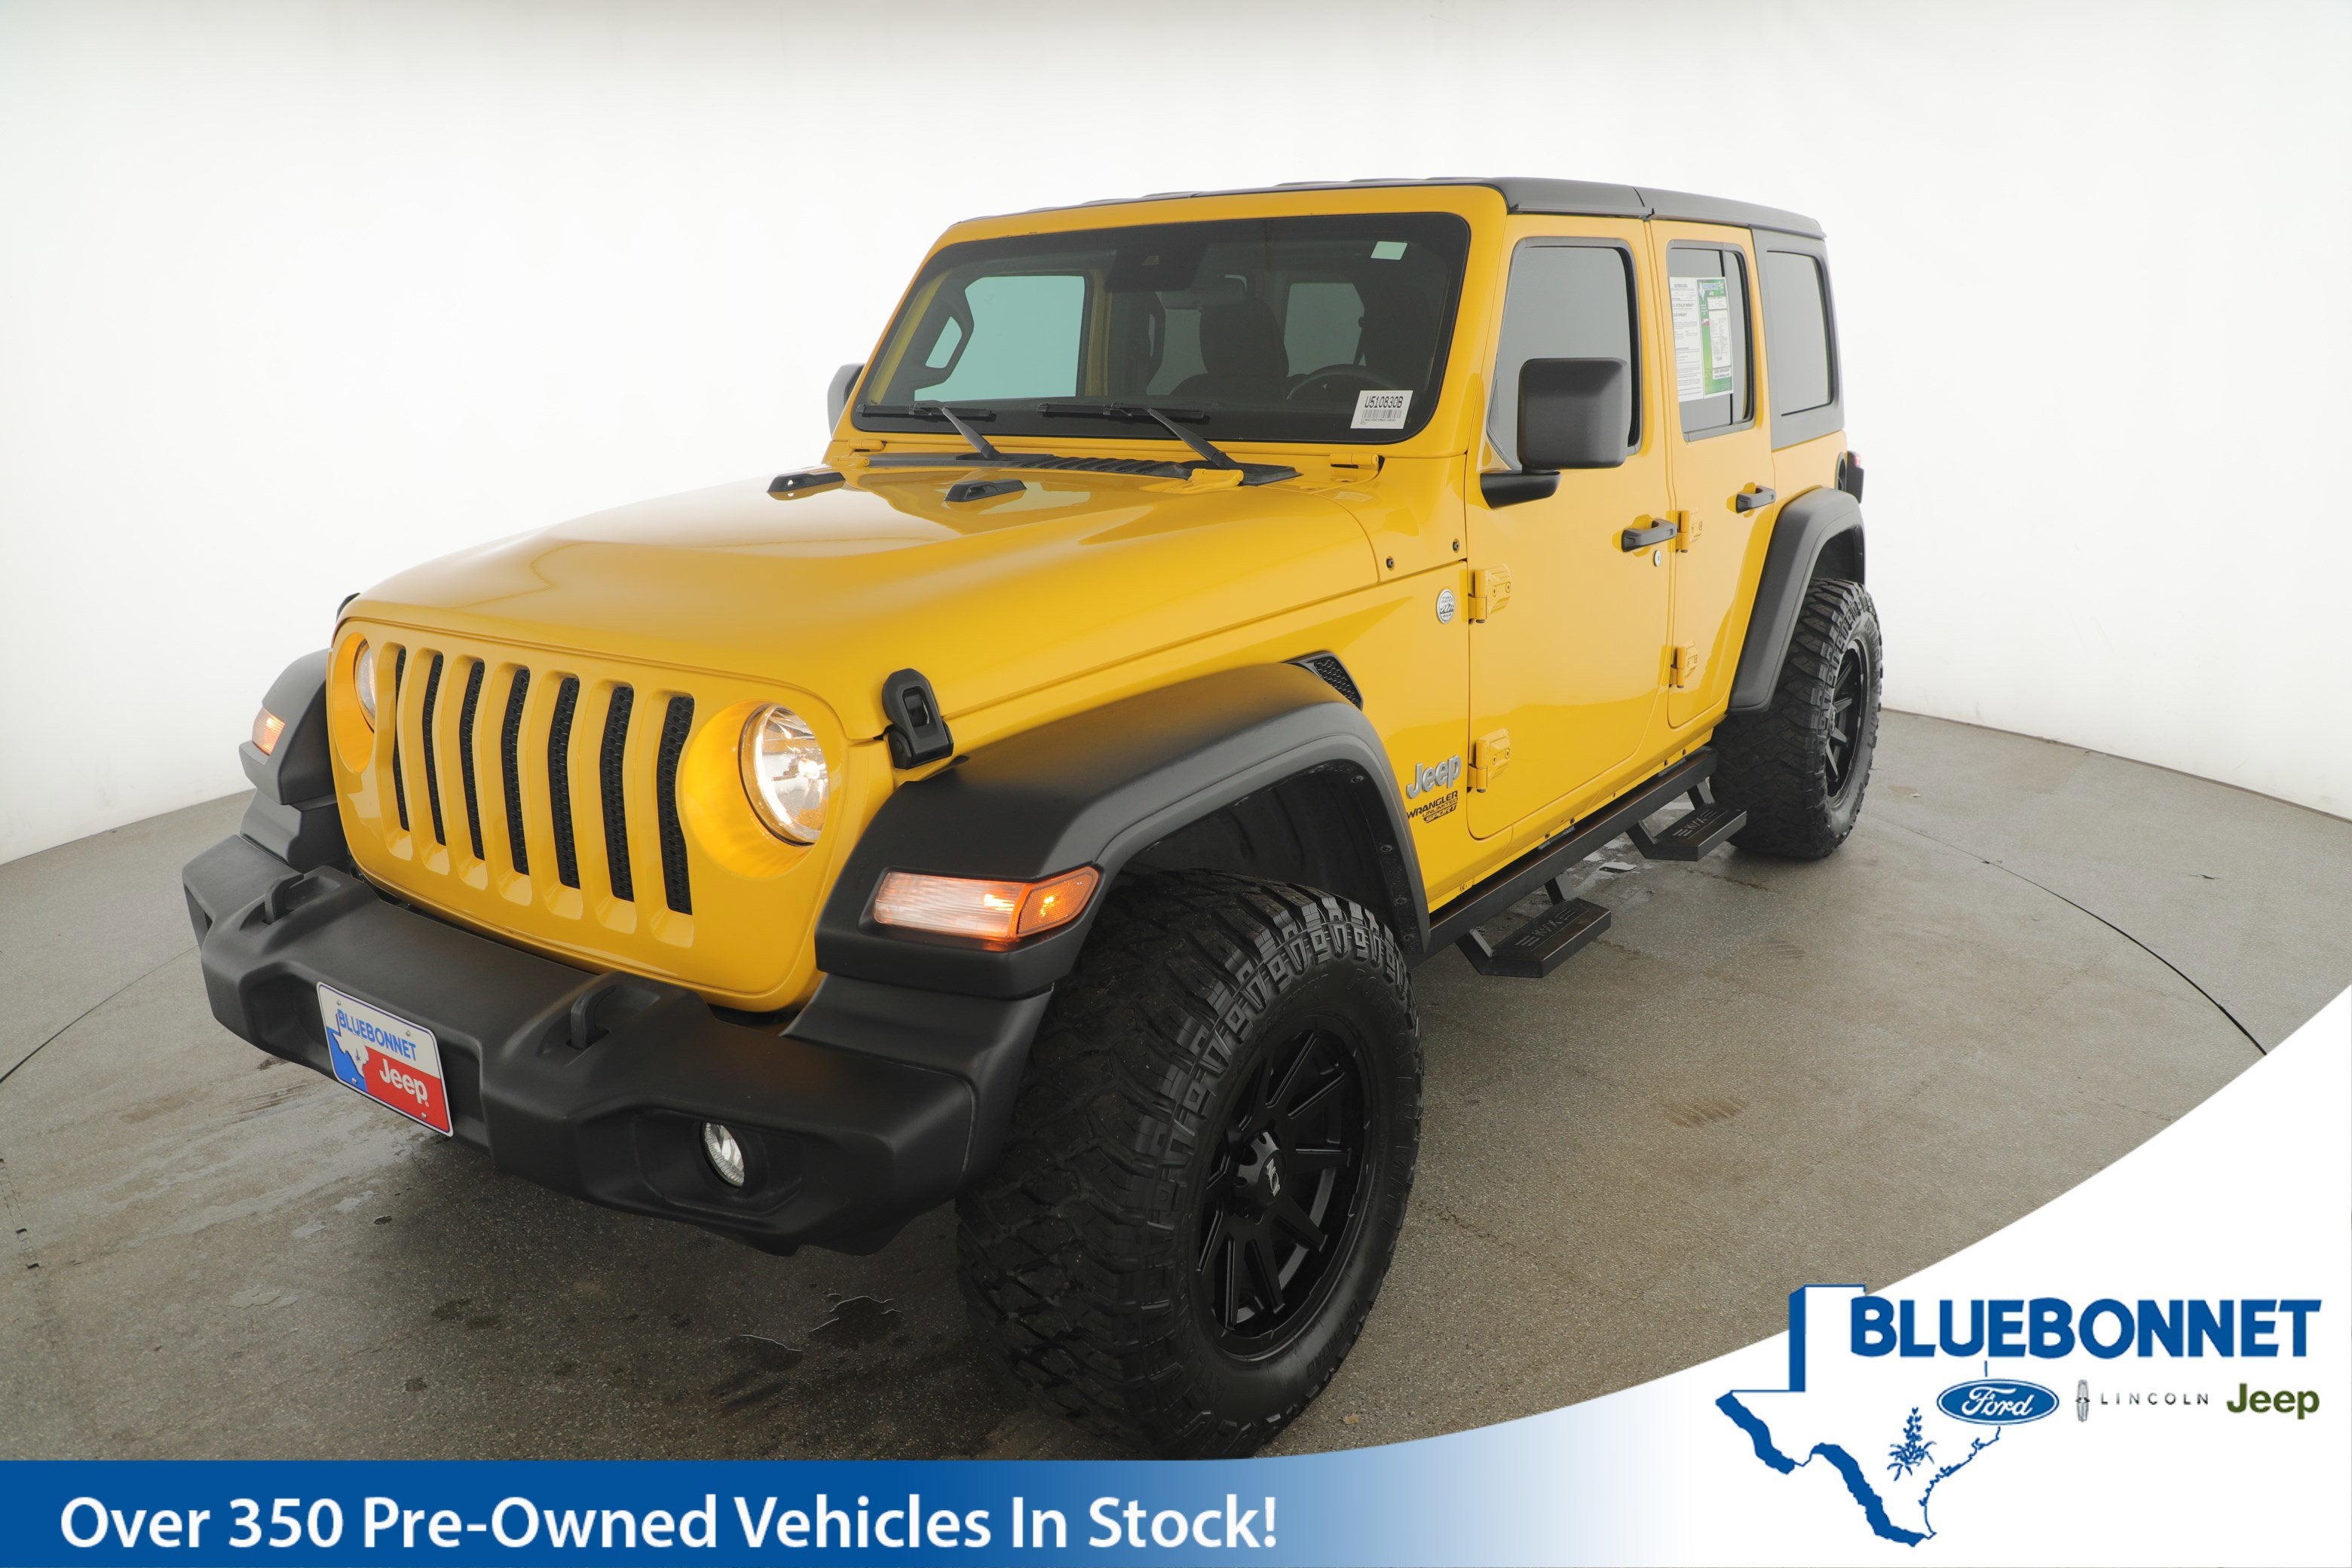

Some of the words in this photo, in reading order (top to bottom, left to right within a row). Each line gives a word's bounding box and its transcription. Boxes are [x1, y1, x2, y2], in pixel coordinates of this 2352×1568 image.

[1364, 396, 1404, 409] U510830B
[1406, 755, 1462, 799] Jeep
[1407, 790, 1458, 819] WRANGLER
[337, 1009, 416, 1061] BLUEBONNET
[379, 1058, 429, 1104] Jeep
